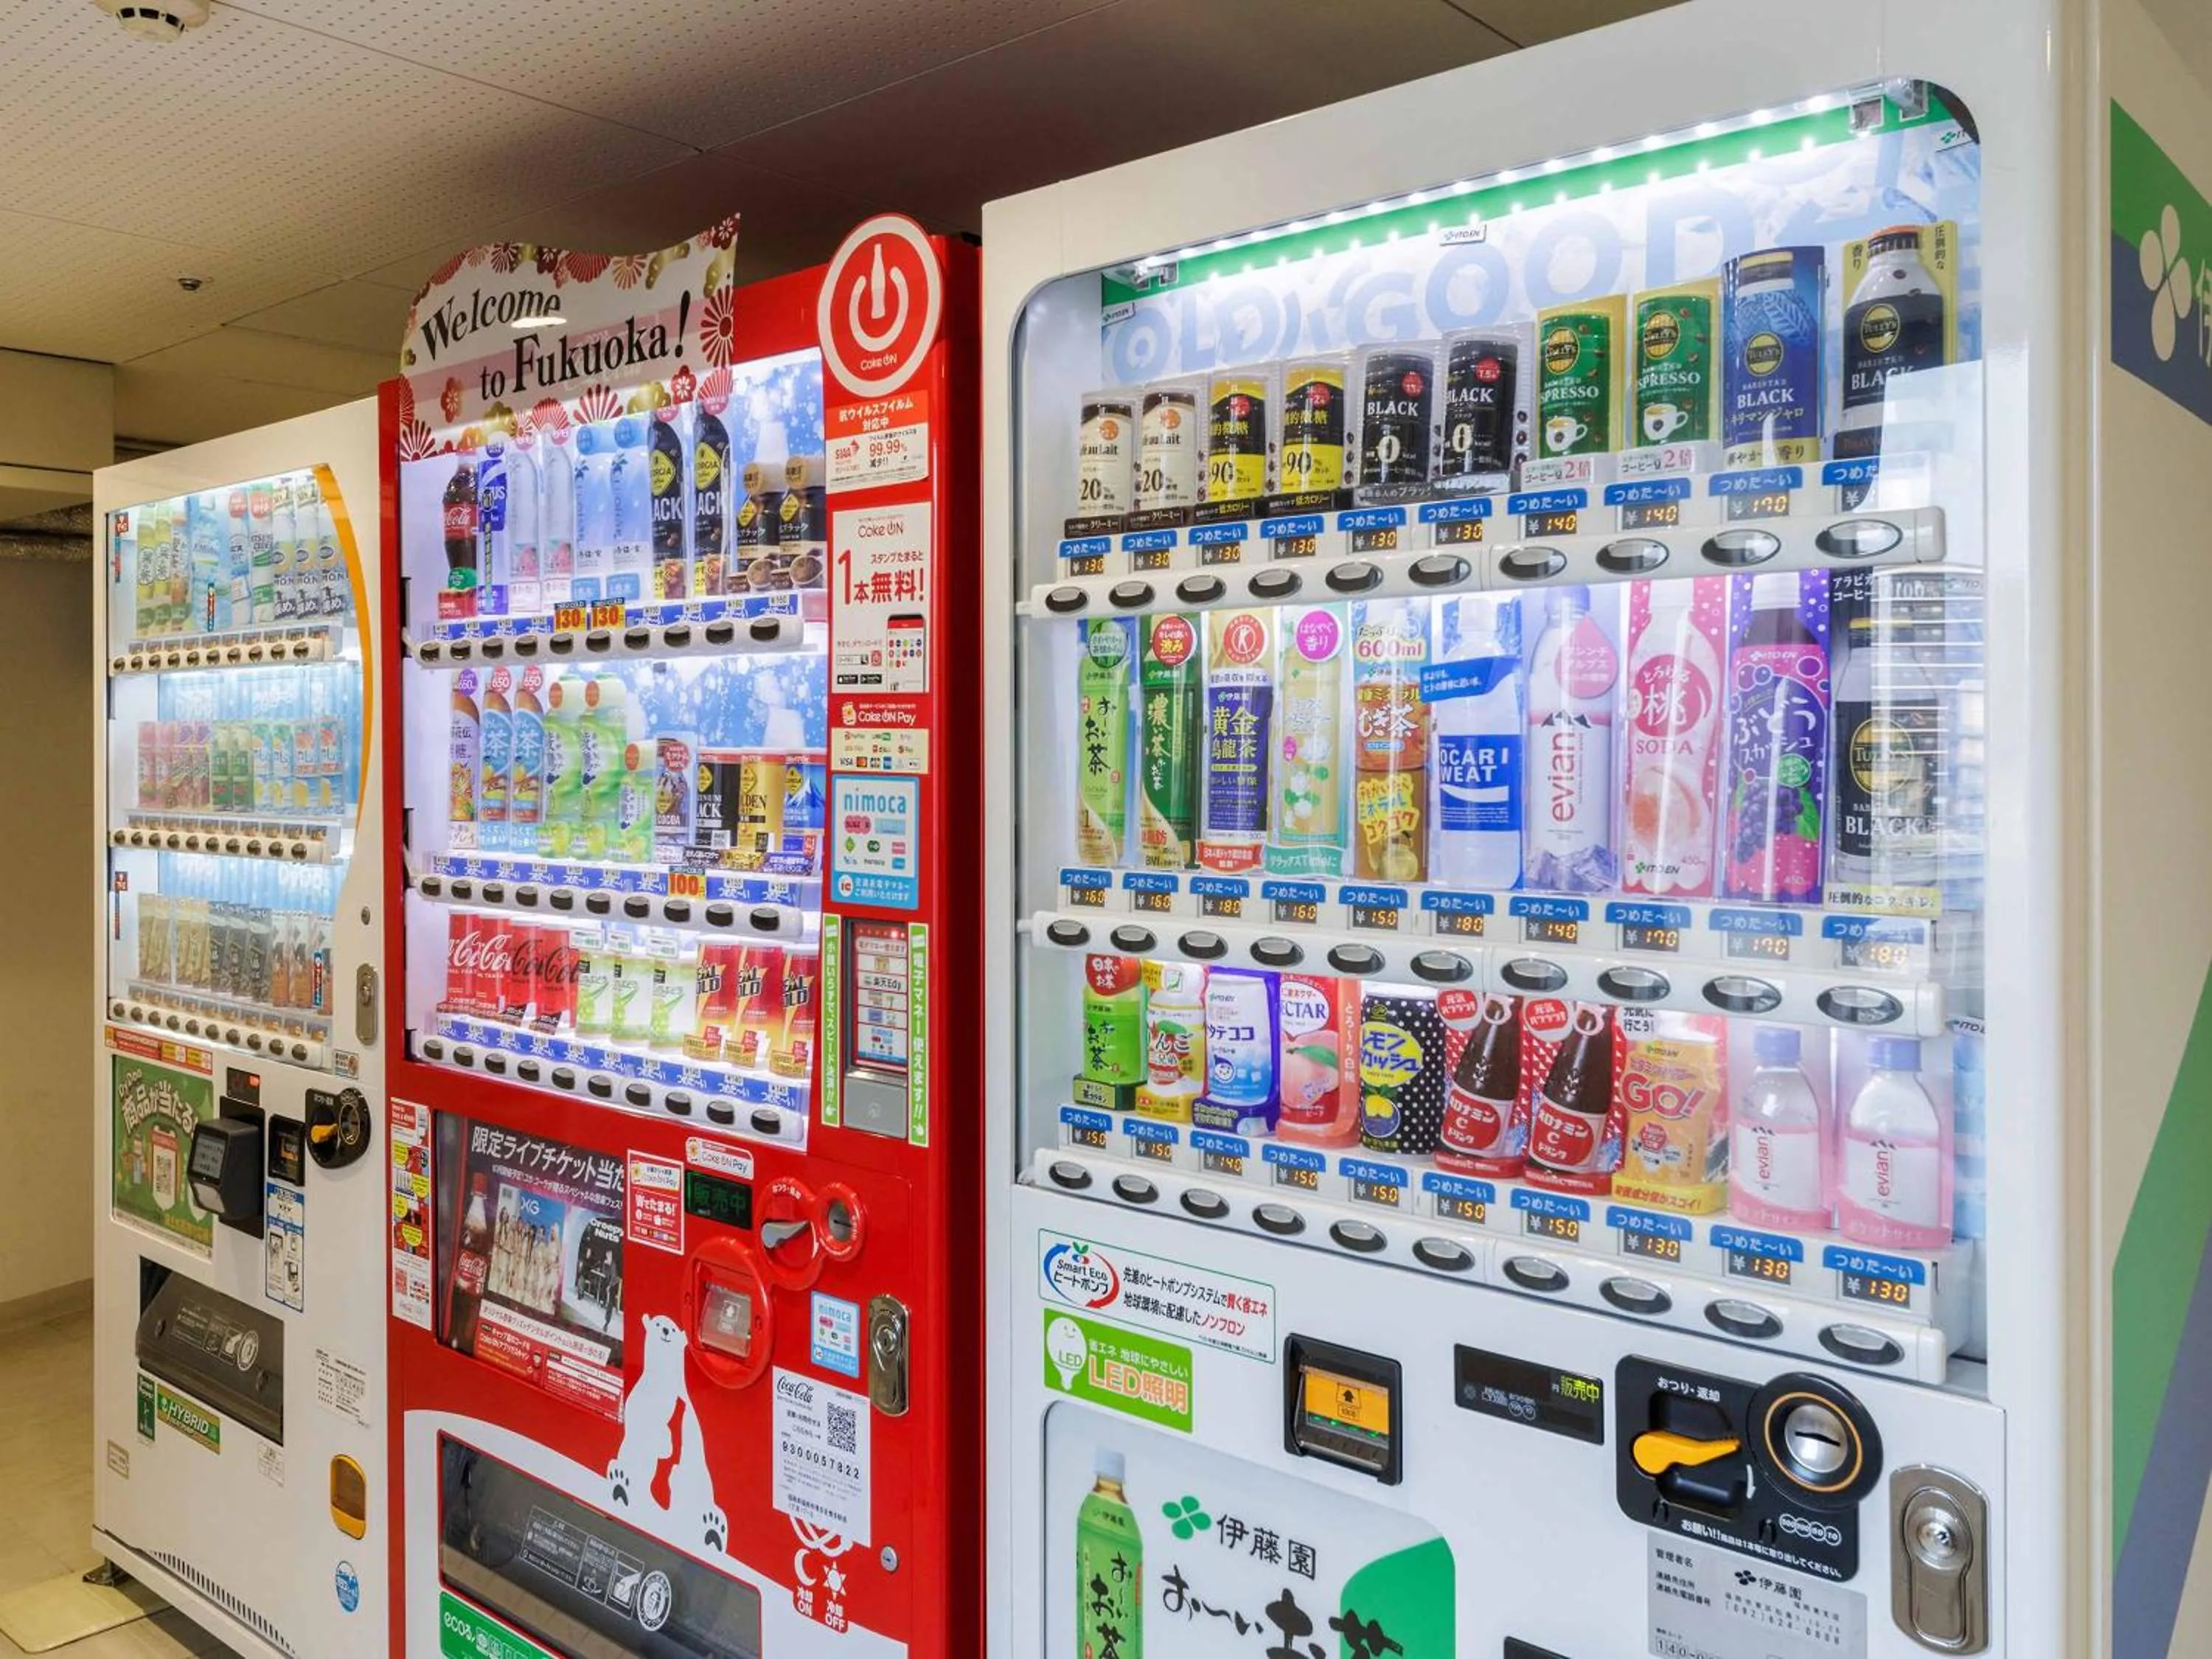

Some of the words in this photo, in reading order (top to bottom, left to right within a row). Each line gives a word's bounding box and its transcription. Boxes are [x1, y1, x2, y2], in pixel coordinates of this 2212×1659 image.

[421, 289, 562, 361] Welcome
[481, 364, 506, 400] to
[512, 289, 690, 392] Fukuoka!
[1368, 401, 1419, 417] BLACK
[1447, 388, 1494, 405] BLACK
[1738, 389, 1794, 408] BLACK
[1304, 634, 1329, 652] 香り
[1644, 684, 1688, 727] 桃
[1212, 706, 1259, 737] 黄金
[1358, 705, 1419, 738] むぎ茶
[1733, 696, 1816, 745] ぶどう
[1441, 747, 1509, 765] OCARI
[1635, 740, 1694, 756] SODA
[1441, 765, 1498, 784] WEAT
[1548, 731, 1576, 824] evian
[844, 787, 907, 815] nimoca
[669, 874, 699, 895] 100
[1622, 1072, 1705, 1119] GO!
[1759, 1136, 1771, 1180] evian
[1877, 1148, 1891, 1198] evian
[1057, 1258, 1087, 1275] Smart
[1088, 1266, 1107, 1279] Eco
[1053, 1272, 1110, 1295] ヒートポンプ
[818, 1304, 852, 1323] nimoca
[1058, 1349, 1083, 1368] LED
[1088, 1339, 1117, 1357] 省エネ
[1120, 1348, 1189, 1378] 地球にやさしい
[1088, 1355, 1189, 1413] LED照明
[1560, 1375, 1600, 1403] 販売中
[1656, 1376, 1721, 1402] おつり・返却
[167, 1399, 209, 1435] HYBRID
[1217, 1513, 1316, 1582] 伊藤園
[1656, 1548, 1694, 1569] 管理者名
[1759, 1576, 1802, 1601] 伊藤園
[796, 1600, 813, 1618] ON
[824, 1613, 845, 1632] OFF
